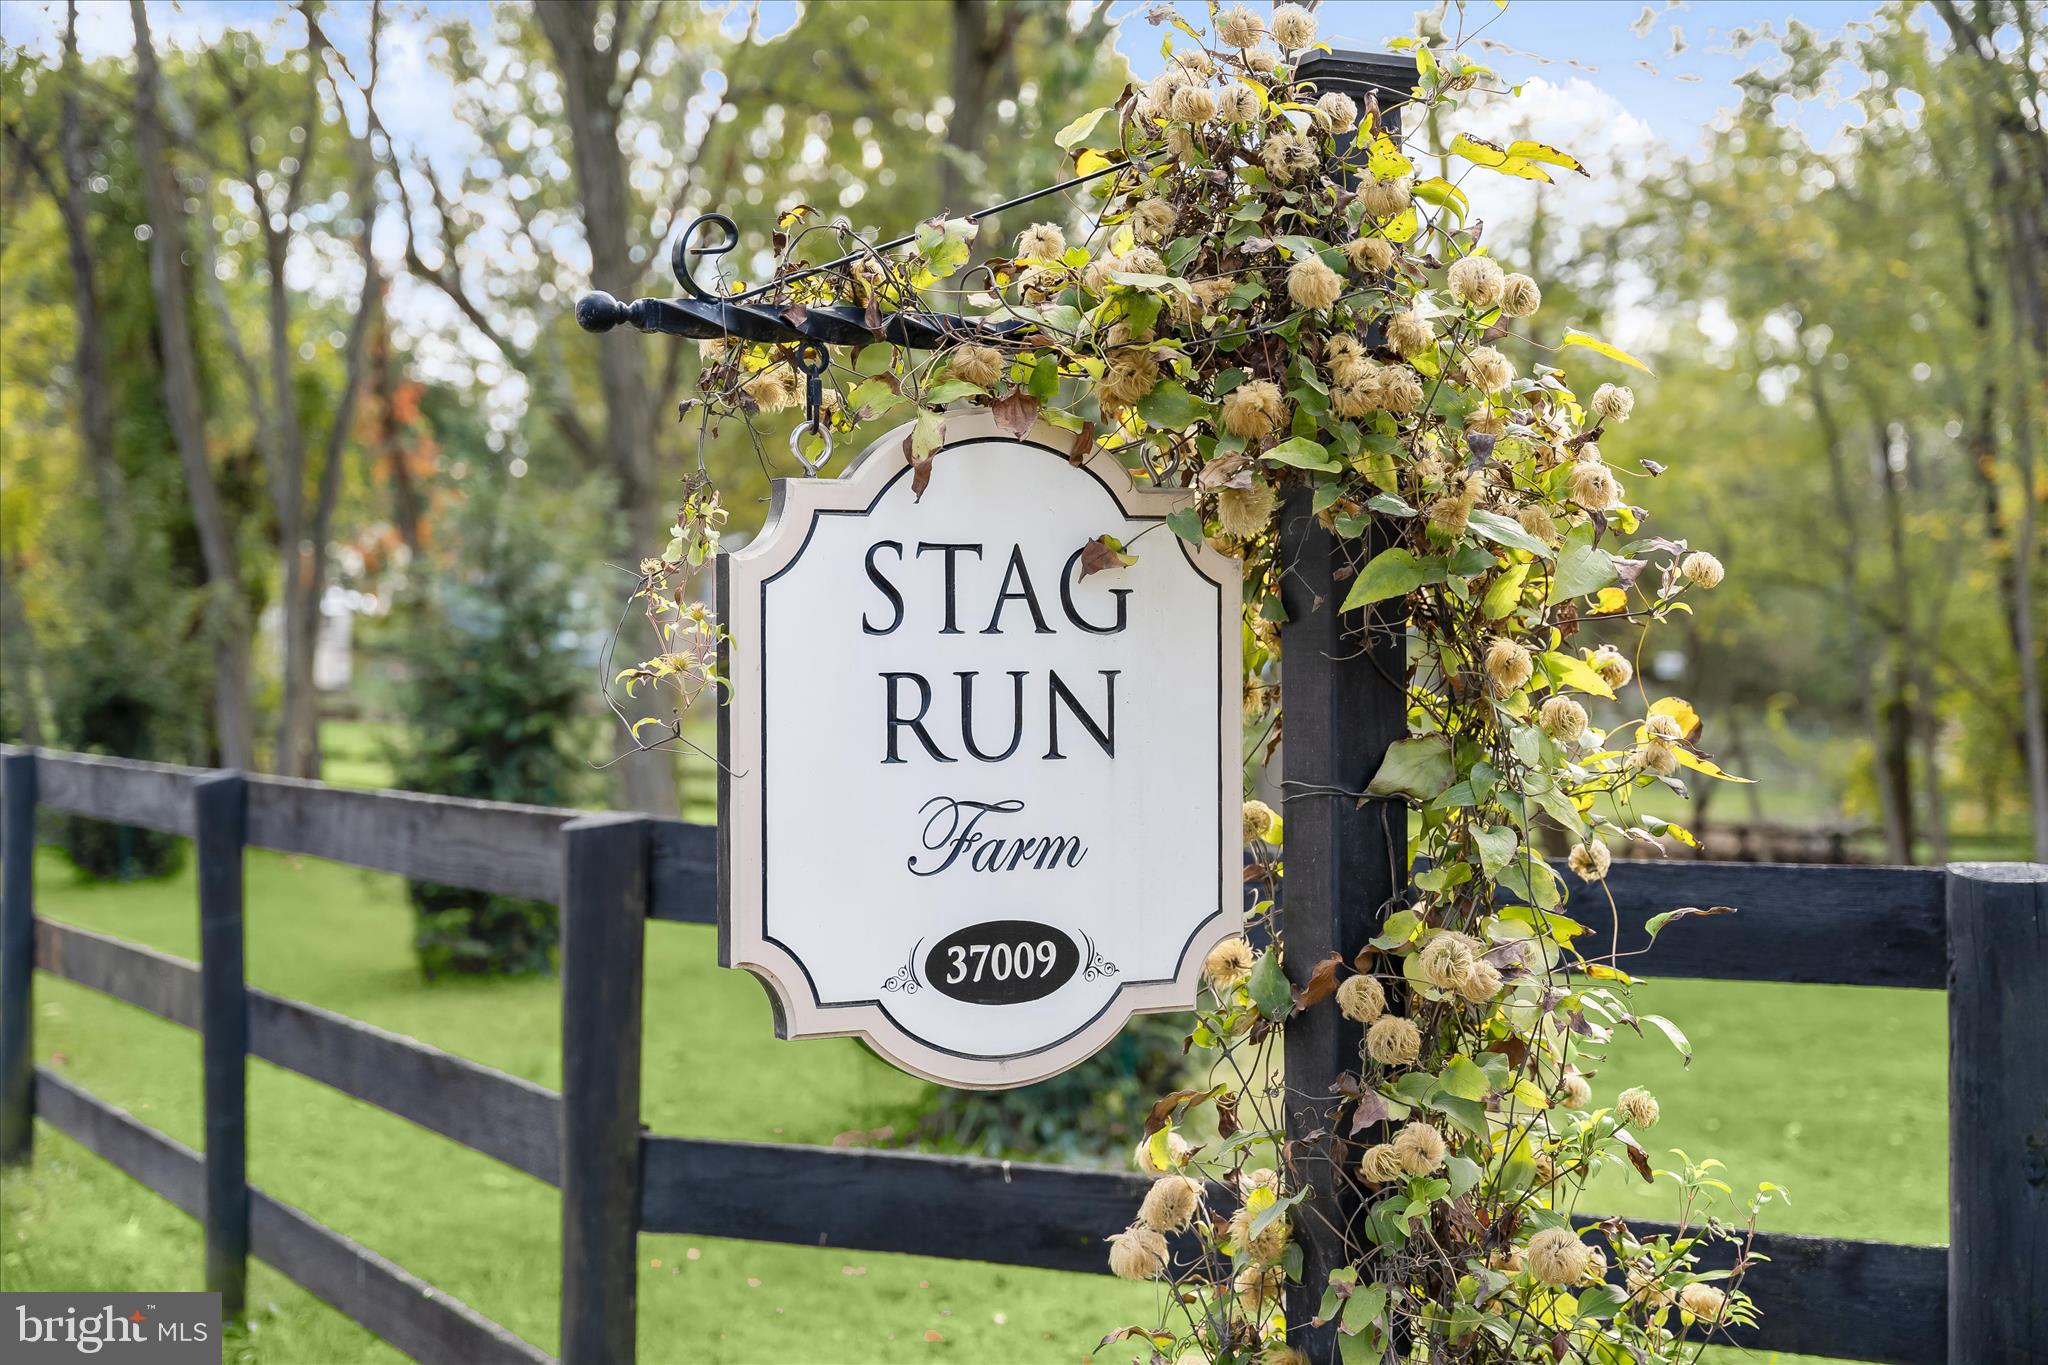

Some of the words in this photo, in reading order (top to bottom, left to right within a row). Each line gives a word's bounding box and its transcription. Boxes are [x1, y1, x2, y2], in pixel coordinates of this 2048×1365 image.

[862, 539, 1134, 636] STAG
[878, 669, 1122, 764] RUN
[907, 795, 1089, 877] Farm
[945, 939, 1057, 985] 37009
